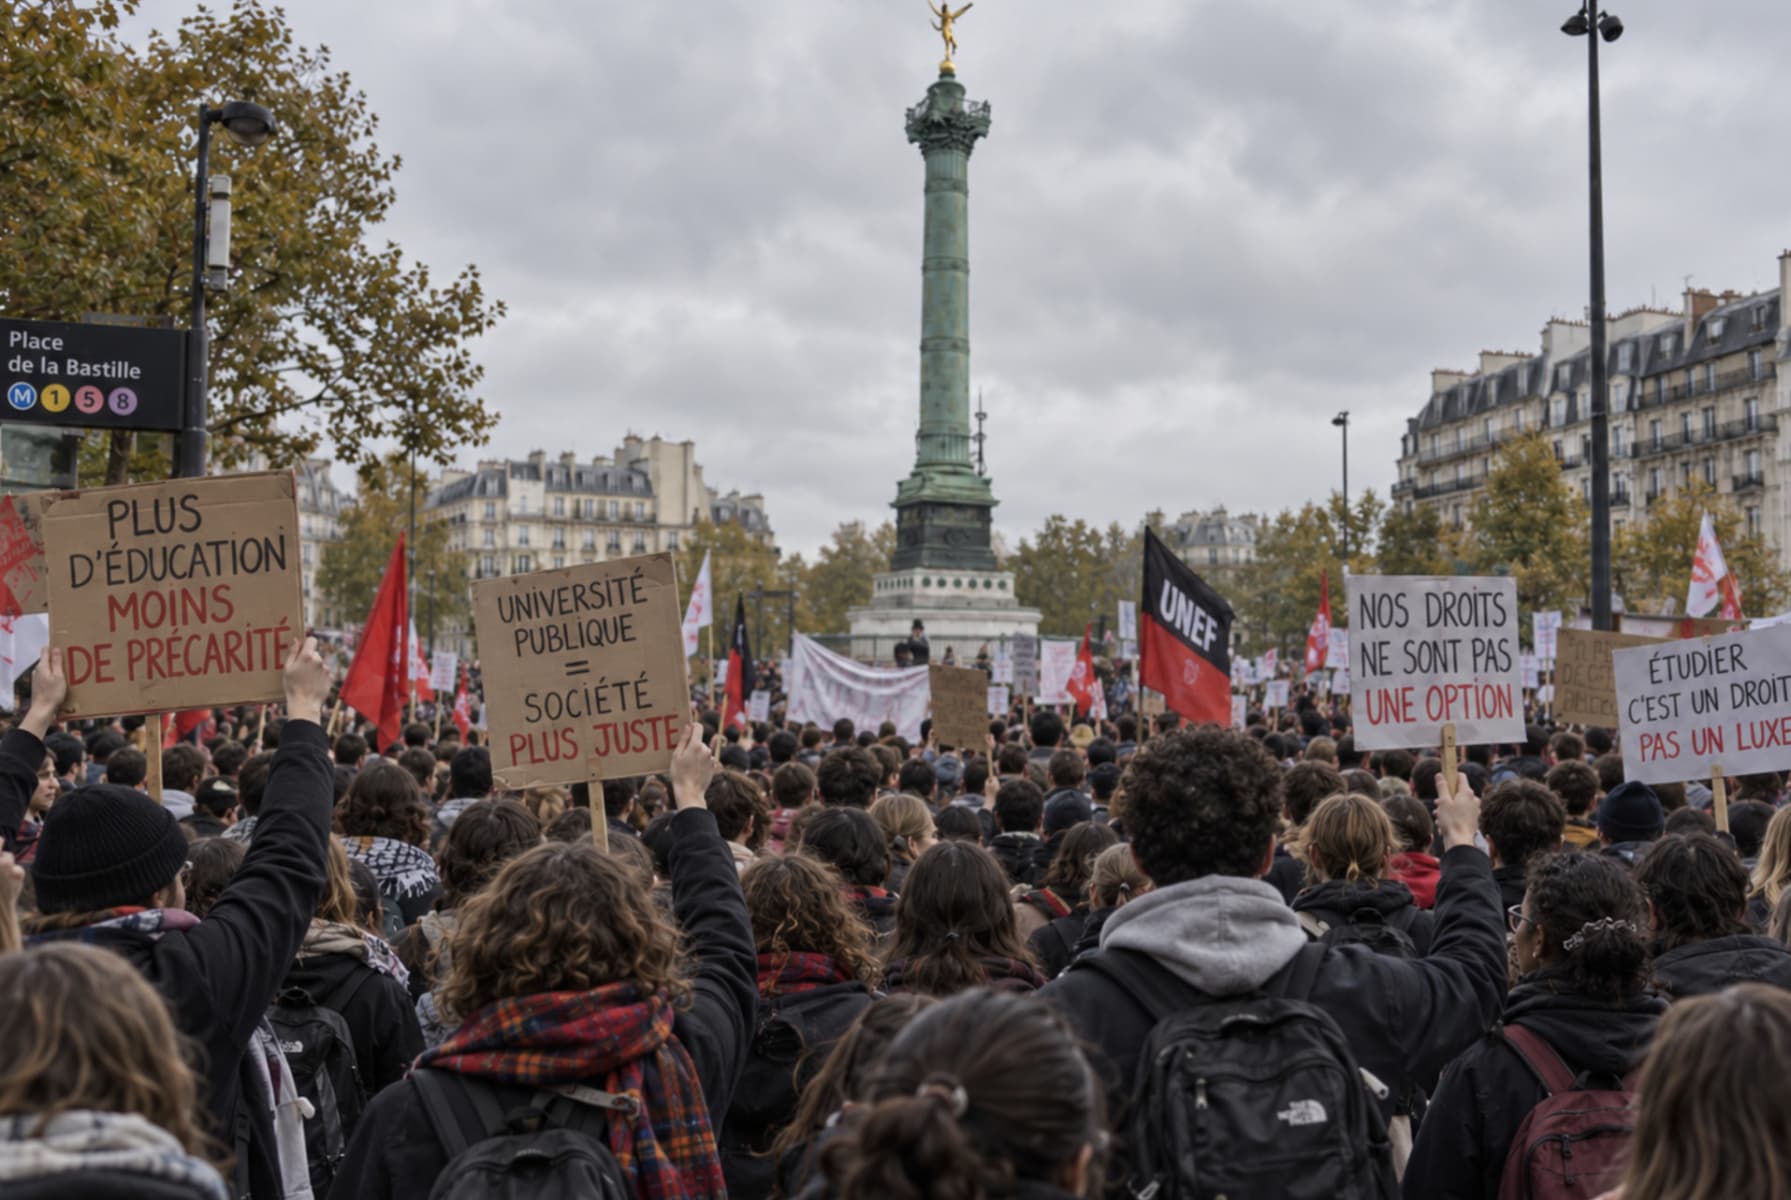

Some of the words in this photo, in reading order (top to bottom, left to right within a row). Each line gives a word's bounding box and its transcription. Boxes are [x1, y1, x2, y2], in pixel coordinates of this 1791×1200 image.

[9, 330, 64, 351] Place
[8, 354, 34, 373] de
[41, 356, 59, 375] la
[66, 358, 142, 380] Bastille
[50, 390, 59, 406] 1
[83, 391, 95, 408] 5
[117, 392, 129, 410] 8
[107, 494, 202, 540] PLUS
[69, 526, 286, 589] D'ÉDUCATION
[107, 583, 234, 632] MOINS
[498, 566, 648, 624] UNIVERSITÉ
[1159, 579, 1218, 652] UNEF
[1360, 592, 1409, 630] NOS
[1425, 586, 1506, 628] DROITS
[67, 644, 115, 686] DE
[127, 616, 291, 681] PRÉCARITÉ
[514, 613, 636, 657] PUBLIQUE
[1361, 641, 1392, 678] NE
[1403, 640, 1462, 674] SONT
[1472, 638, 1512, 673] PAS
[565, 660, 590, 676] =
[1649, 643, 1748, 685] ÉTUDIER
[525, 671, 652, 723] SOCIÉTÉ
[1365, 687, 1416, 725] UNE
[1425, 677, 1513, 721] OPTION
[1628, 692, 1681, 725] C'EST
[1691, 686, 1719, 715] UN
[1730, 673, 1791, 710] DROIT
[509, 728, 578, 766] PLUS
[593, 714, 678, 758] JUSTE
[1640, 730, 1681, 762] PAS
[1692, 725, 1724, 756] UN
[1736, 716, 1791, 752] LUXE
